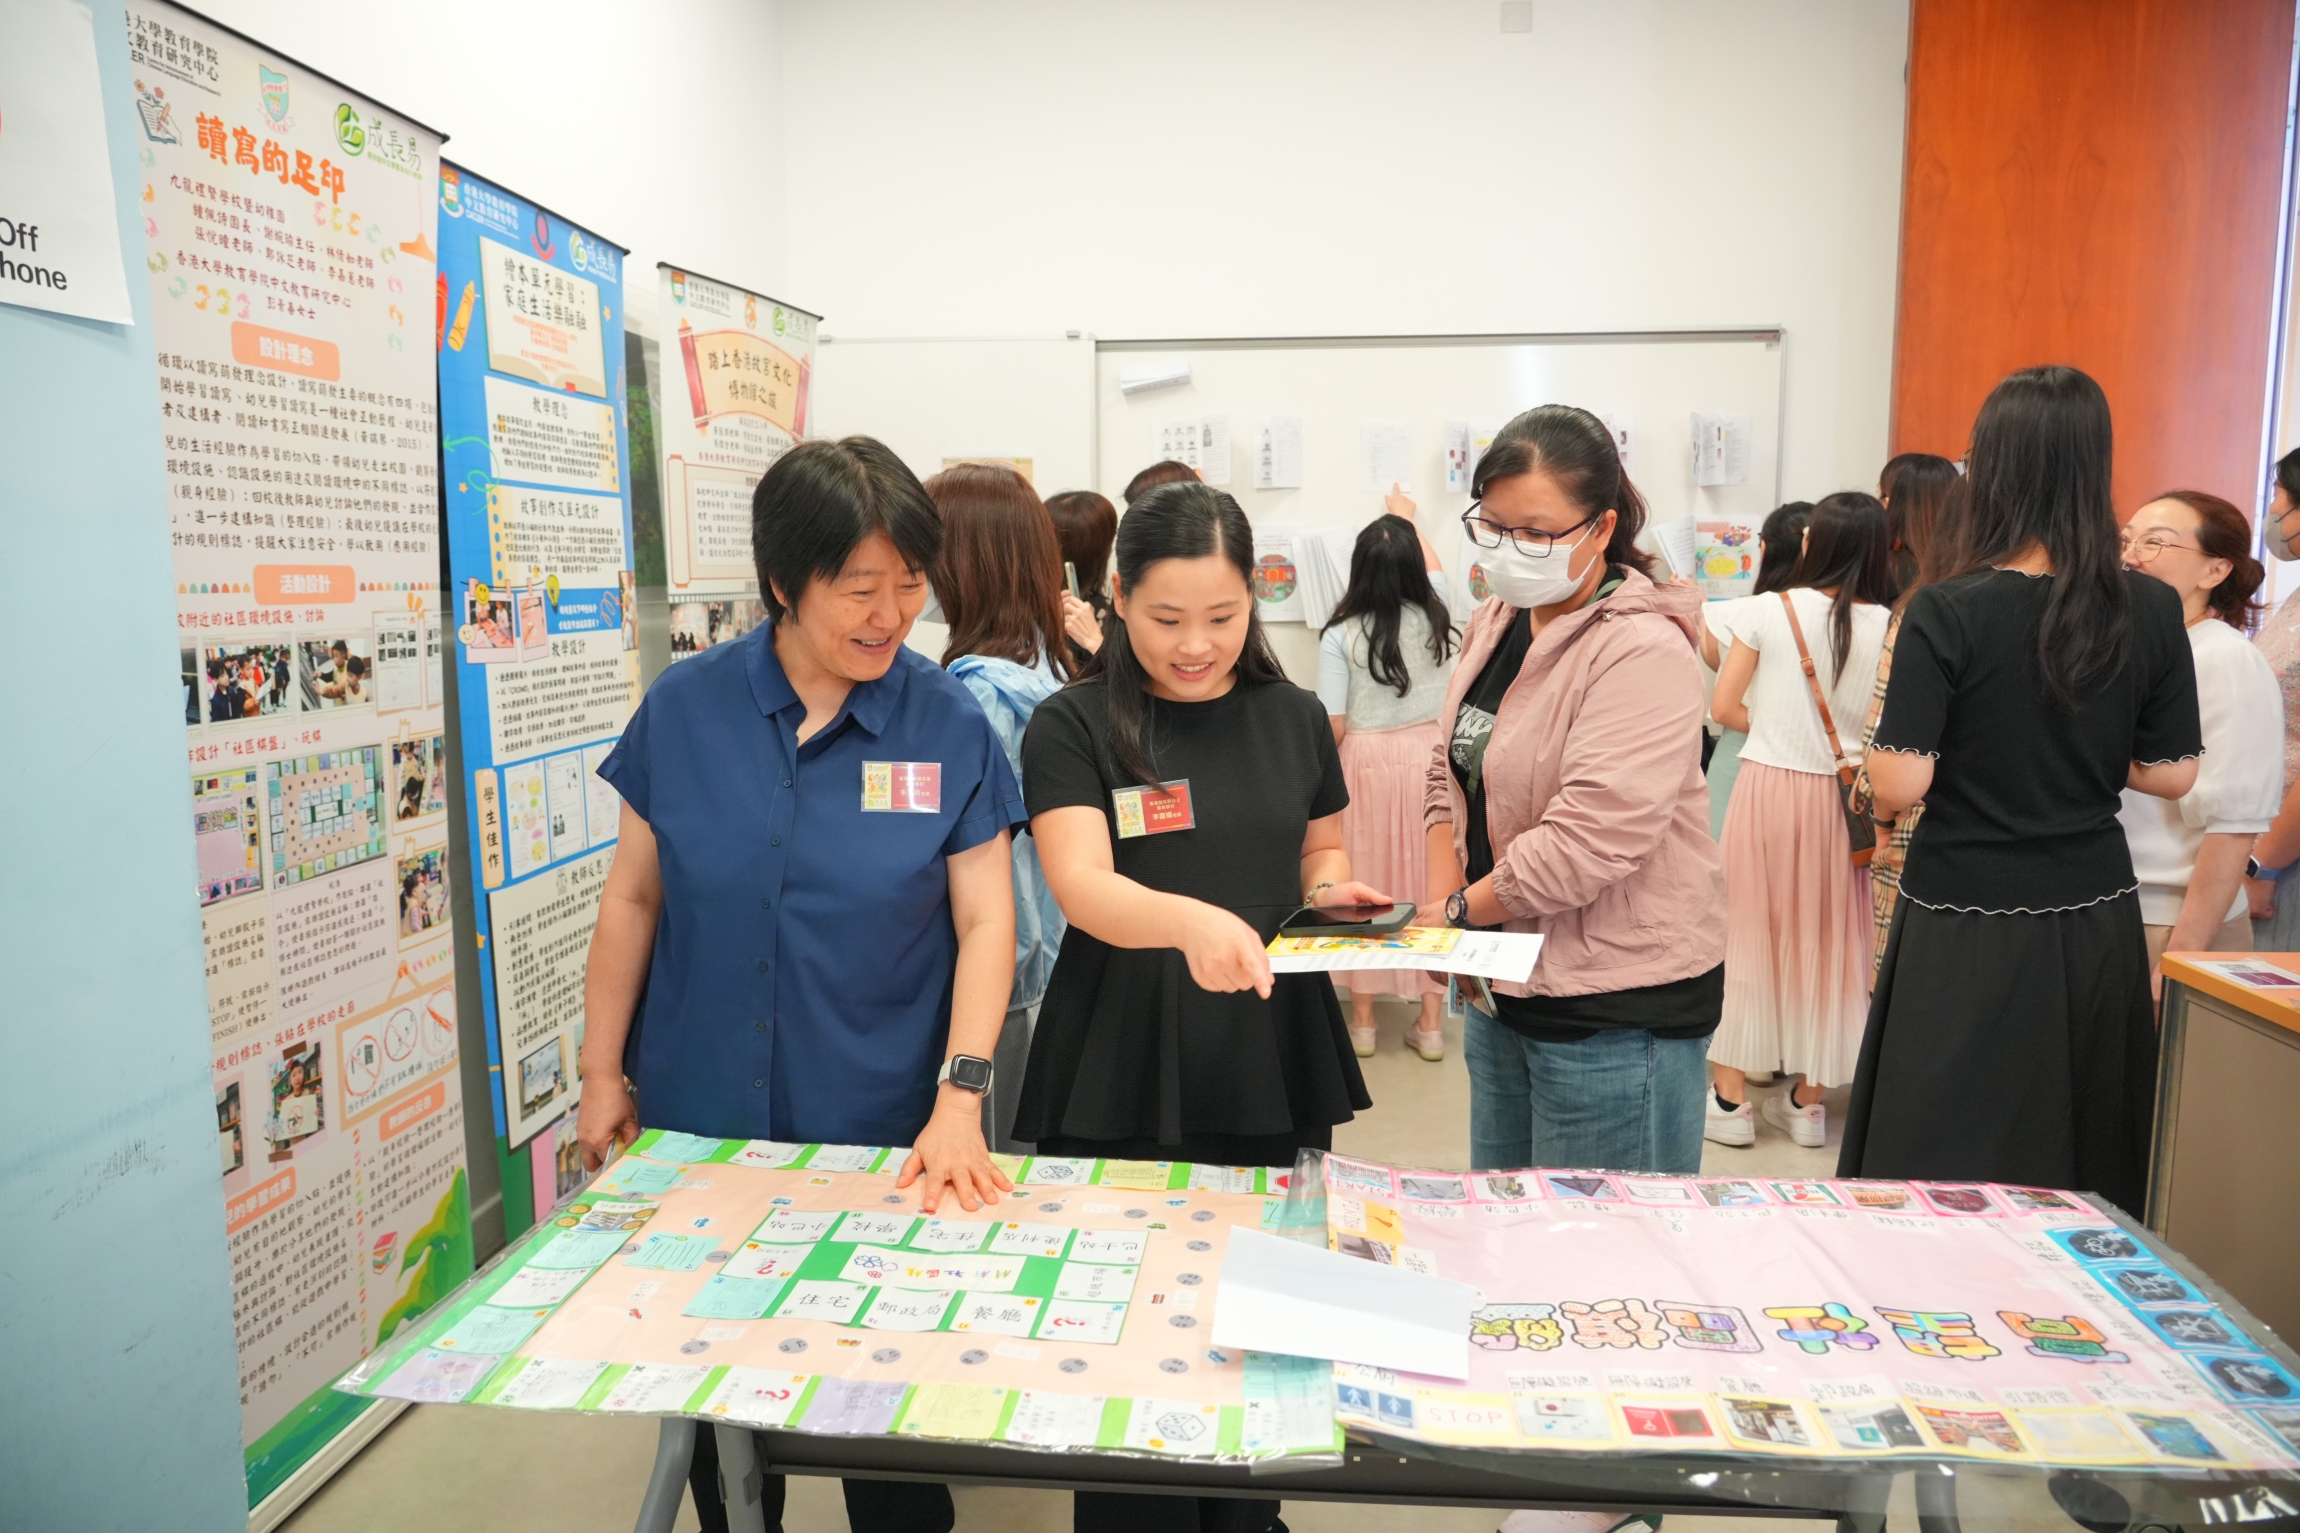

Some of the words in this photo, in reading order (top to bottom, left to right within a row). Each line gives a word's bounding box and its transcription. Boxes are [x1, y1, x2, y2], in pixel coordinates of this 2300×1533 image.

[367, 116, 421, 172] 成長易
[196, 112, 346, 205] 讀寫的足印
[0, 217, 38, 252] Off
[532, 396, 568, 420] 教學理念
[280, 574, 331, 594] 活動設計
[552, 639, 586, 658] 教學設計
[483, 786, 509, 869] 學生佳作
[212, 1001, 355, 1071] 規則標誌，張貼在學校的走廊
[769, 1219, 828, 1232] 小巴站
[851, 1221, 897, 1234] 學校
[929, 1228, 975, 1240] 住宅
[1003, 1232, 1062, 1245] 便利店
[1079, 1240, 1138, 1251] 巴士站
[799, 1293, 850, 1309] 住宅
[876, 1301, 941, 1316] 郵政局
[973, 1306, 1024, 1322] 餐廳
[1429, 1408, 1503, 1425] STOP
[1943, 1411, 2000, 1422] wellcome
